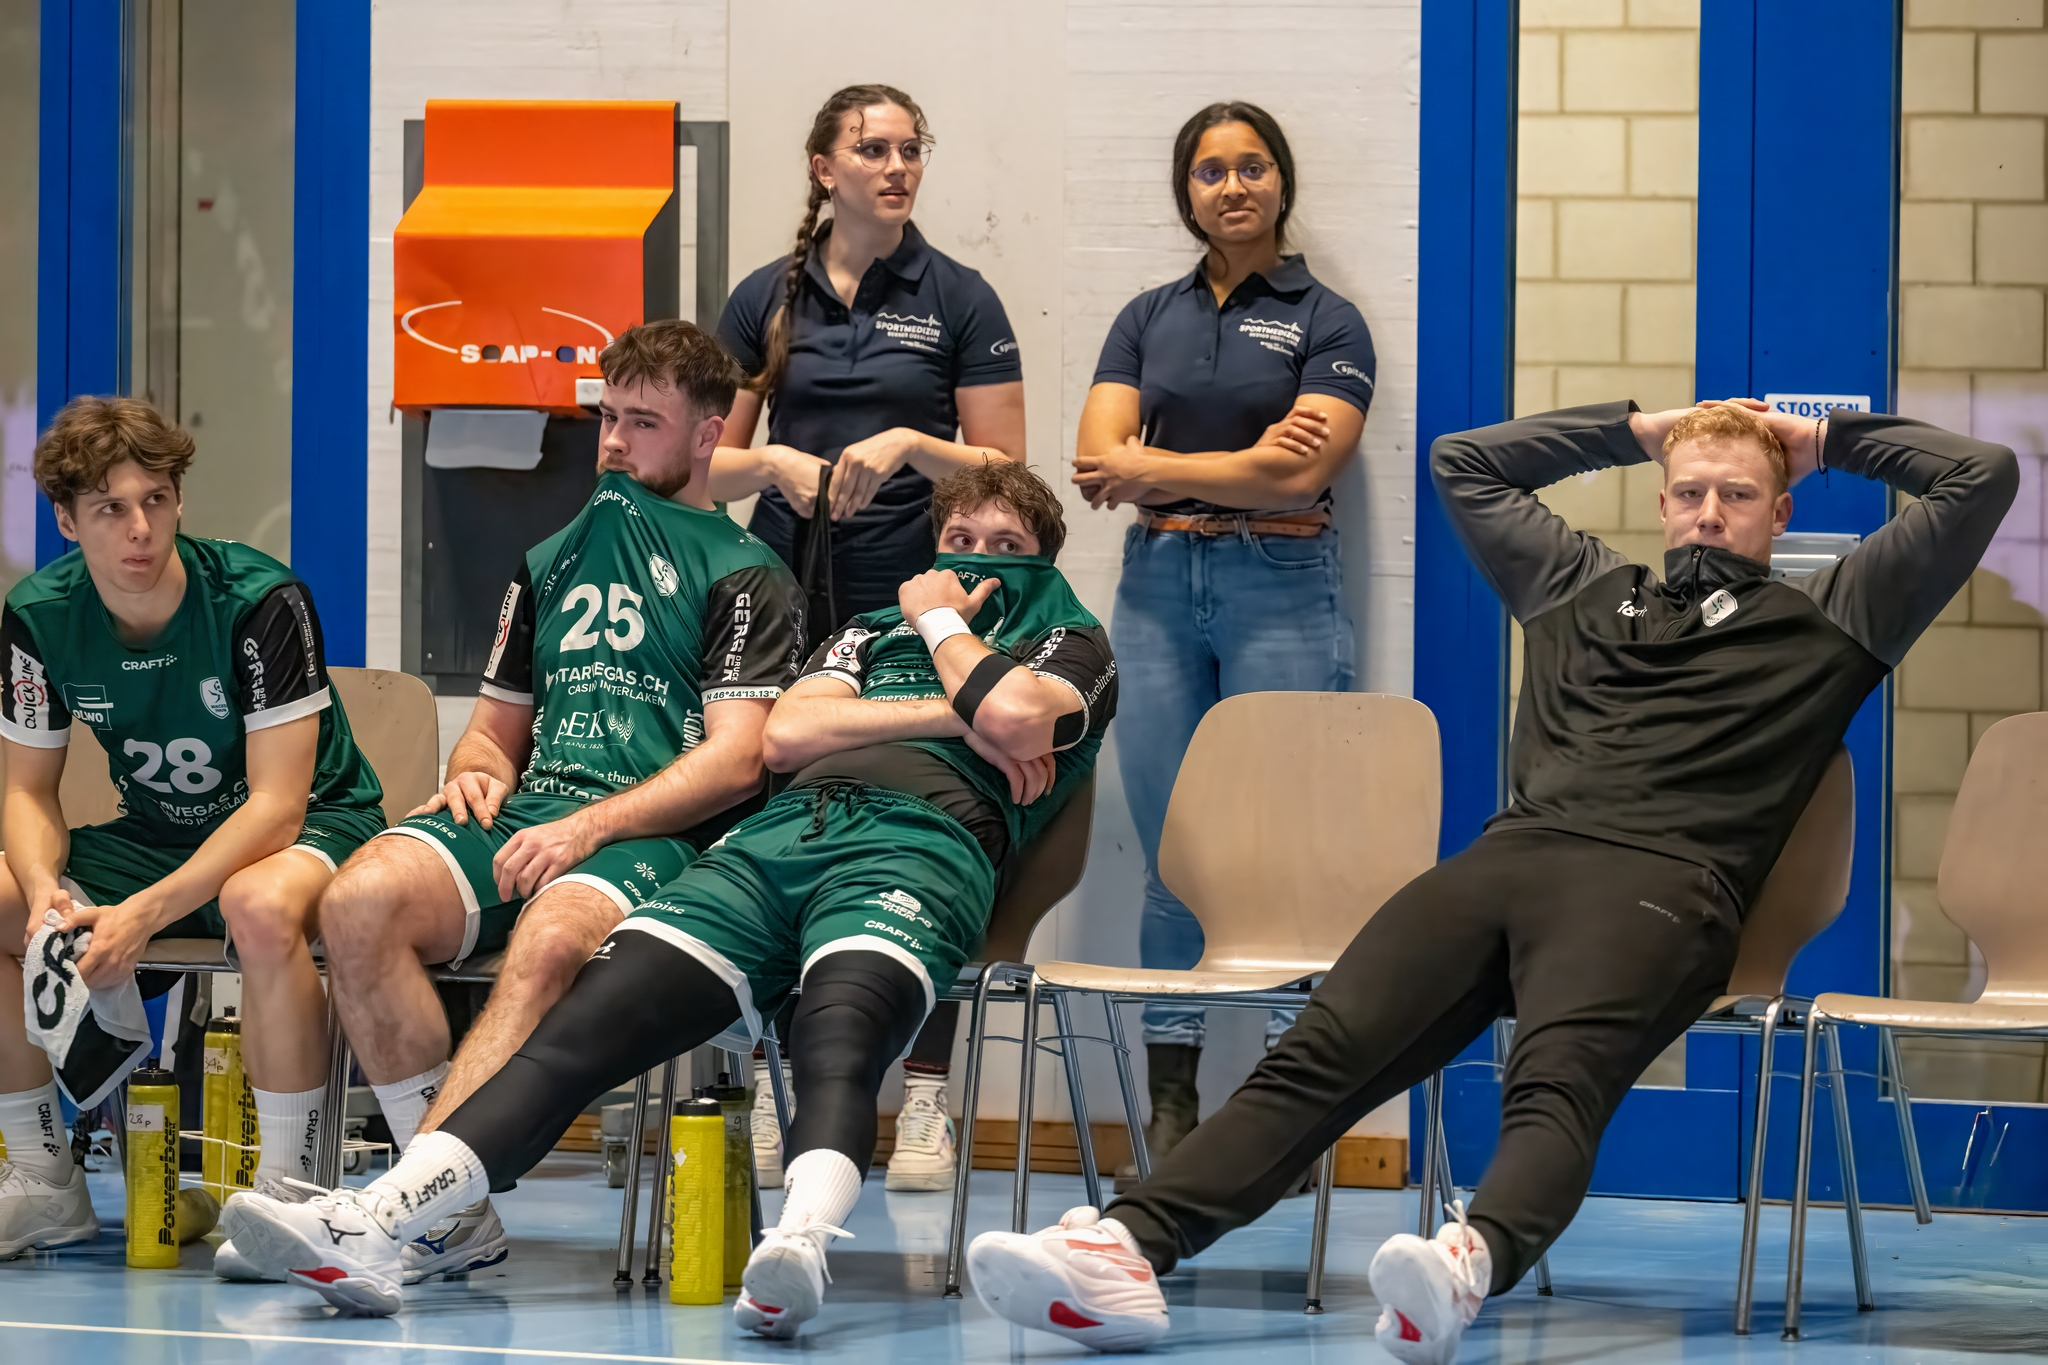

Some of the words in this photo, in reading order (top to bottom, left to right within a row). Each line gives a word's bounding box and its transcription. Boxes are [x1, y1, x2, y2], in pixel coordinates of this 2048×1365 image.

[875, 320, 941, 338] SPORTMEDIZIN
[1238, 324, 1301, 343] SPORTMEDIZIN
[1776, 401, 1860, 418] STOSSN
[593, 489, 631, 507] CRAFT
[957, 570, 980, 583] AFT
[559, 582, 646, 654] 25
[121, 657, 166, 671] CRAFT
[600, 679, 667, 708] INTERLAKEN
[706, 693, 713, 702] N
[72, 709, 104, 723] OLWO
[551, 708, 606, 745] AEK
[122, 737, 223, 795] 28
[607, 770, 637, 785] thun
[395, 818, 457, 840] udoise
[864, 919, 913, 942] CRAFT
[37, 1102, 55, 1139] CRAFT
[304, 1109, 319, 1151] CRAFT
[415, 1167, 457, 1207] CRAFT
